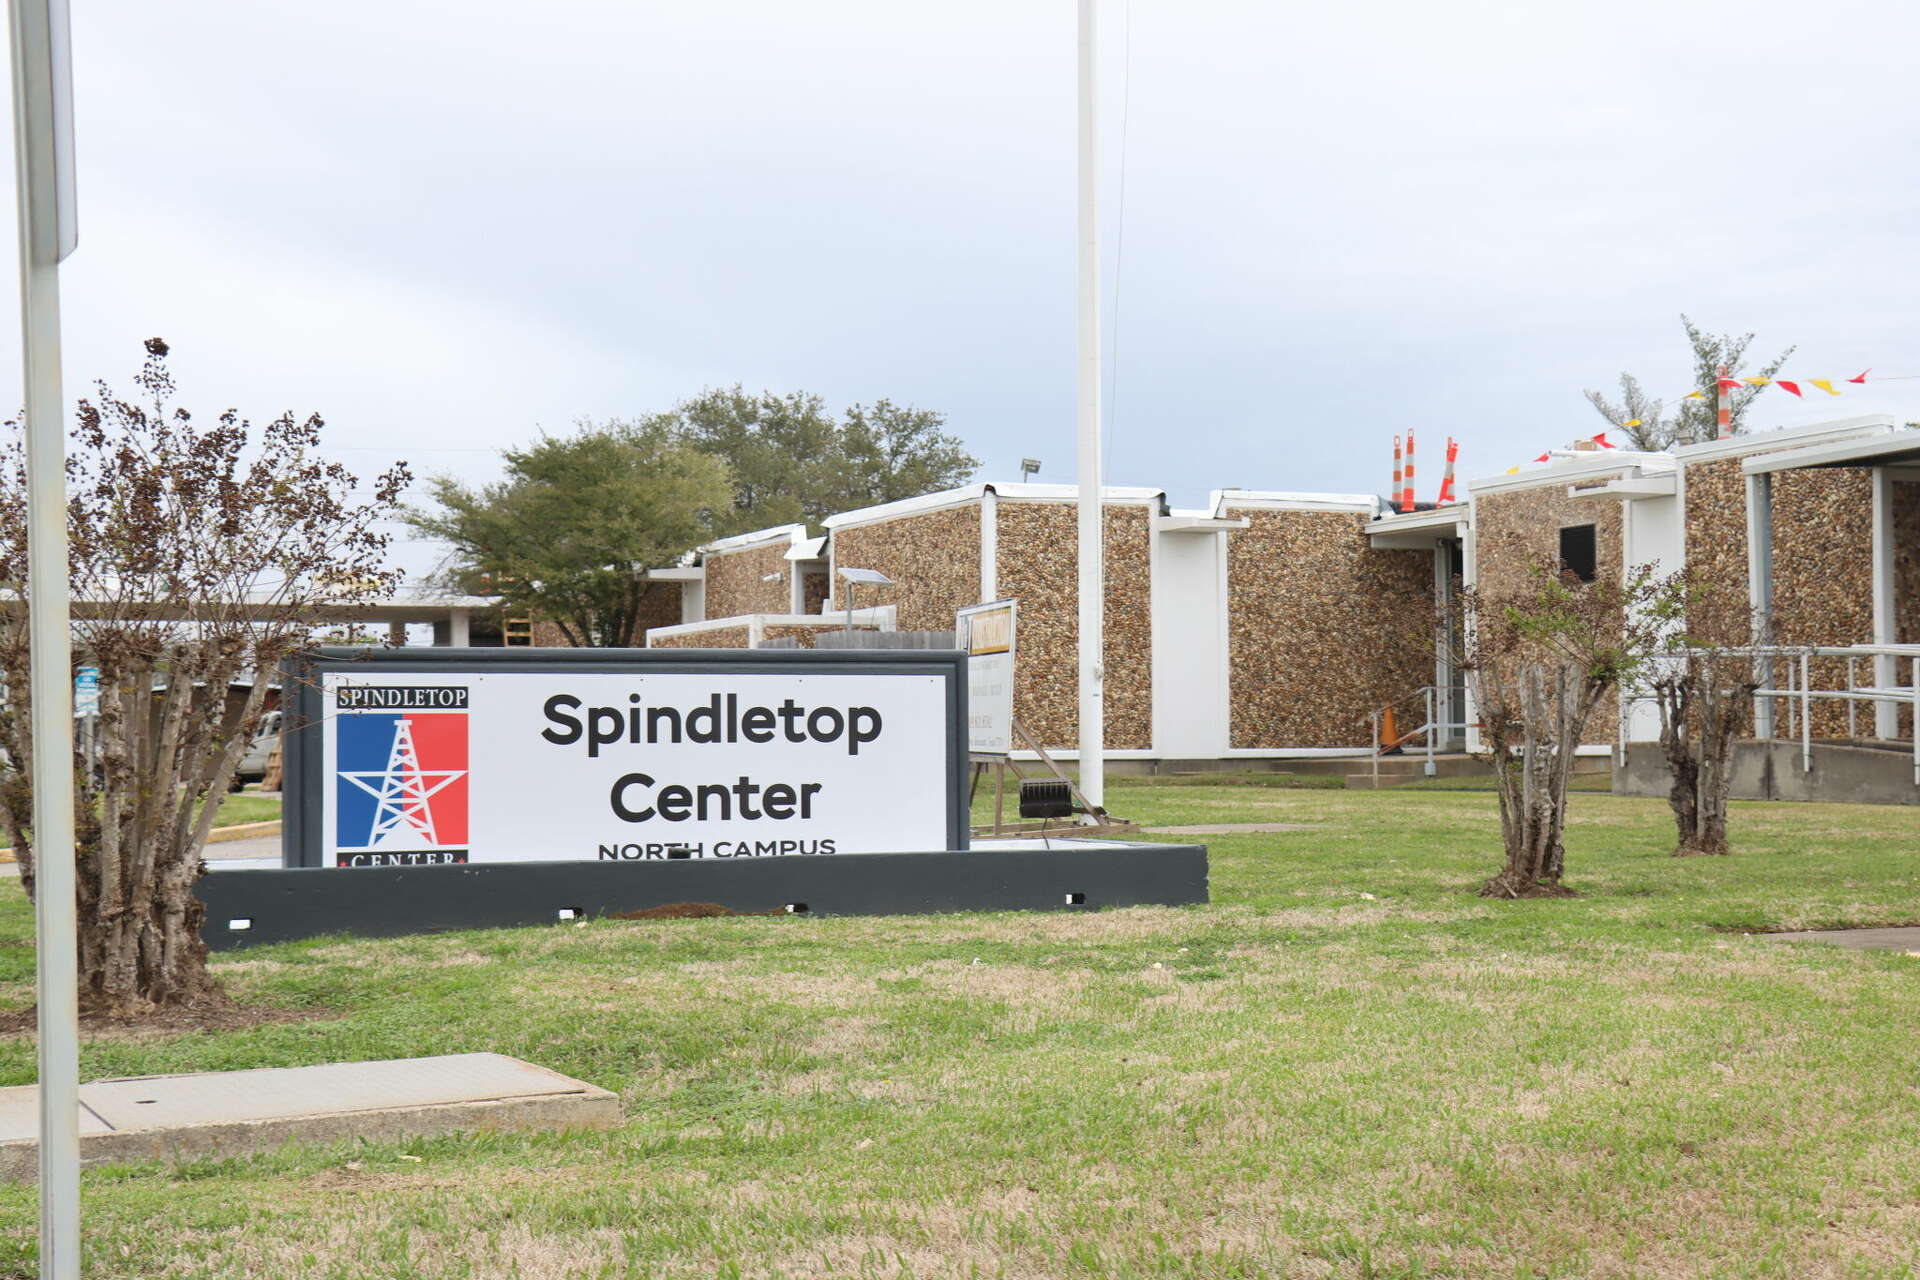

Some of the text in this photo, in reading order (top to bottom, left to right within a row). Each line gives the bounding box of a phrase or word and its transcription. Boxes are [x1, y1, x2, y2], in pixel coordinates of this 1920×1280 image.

[339, 688, 467, 707] SPINDLETOP
[541, 693, 882, 758] Spindletop
[610, 773, 823, 823] Center
[713, 839, 837, 857] CAMPUS
[351, 853, 455, 867] CENTER
